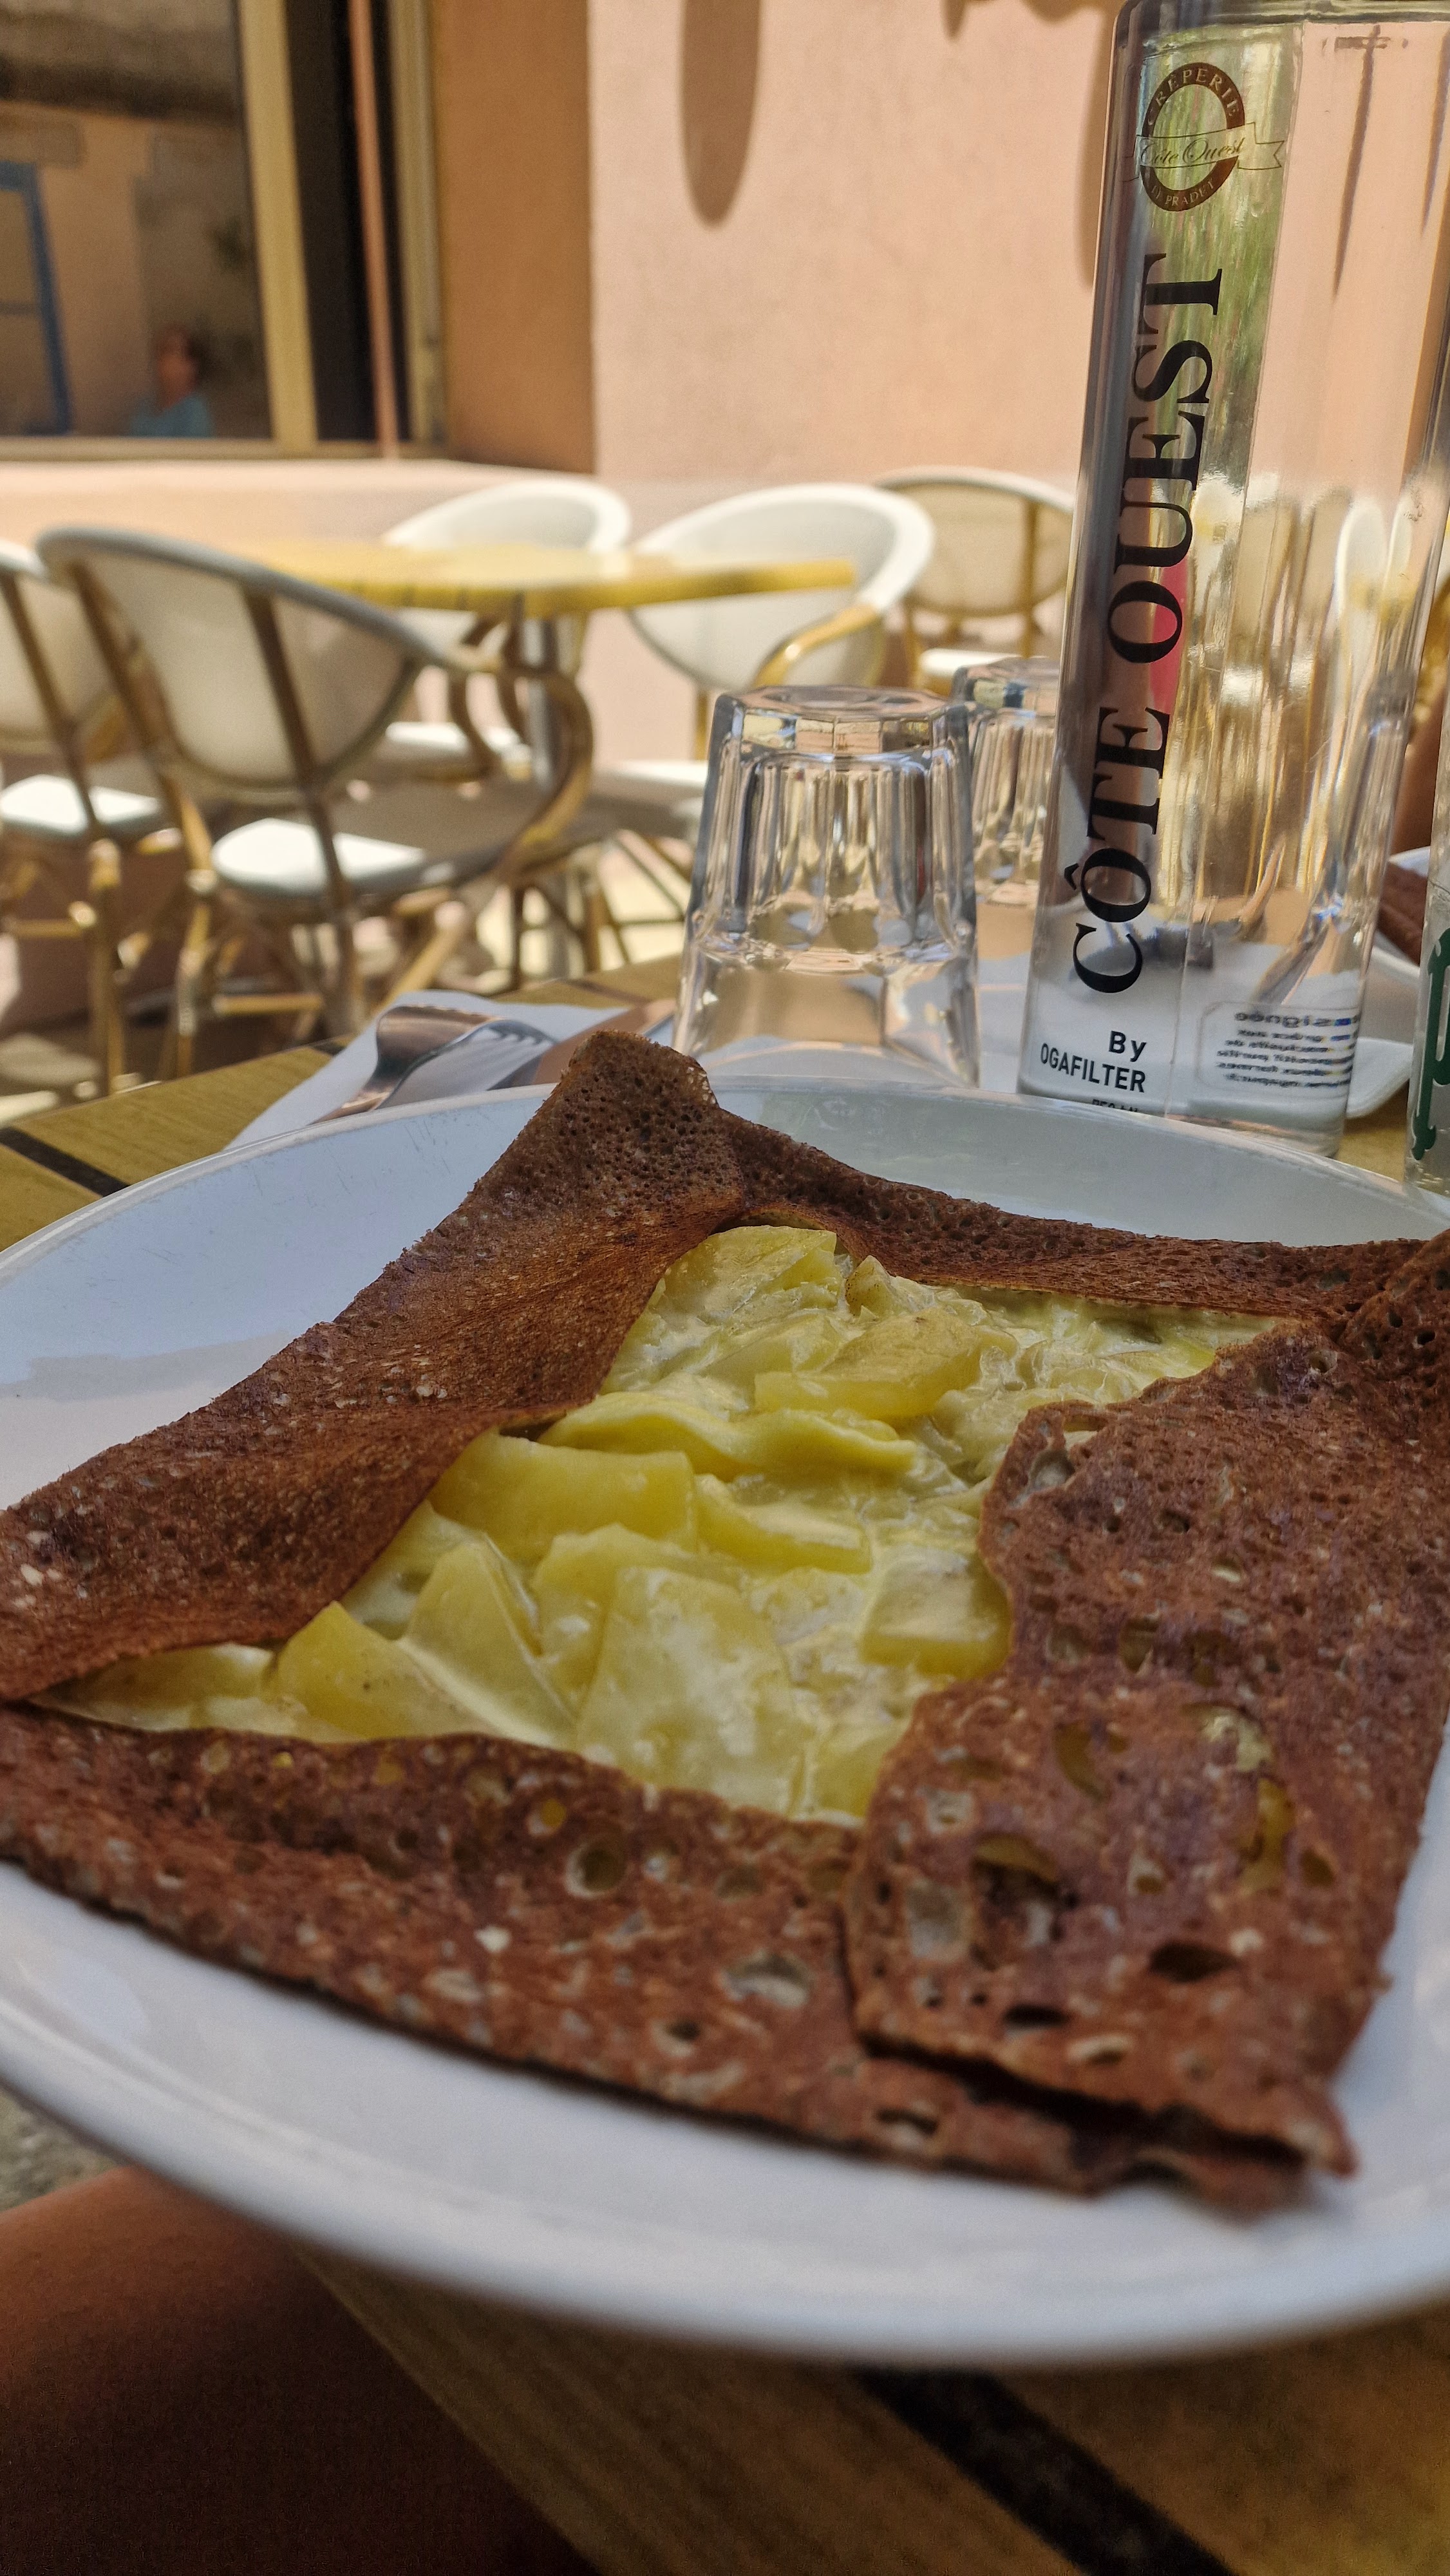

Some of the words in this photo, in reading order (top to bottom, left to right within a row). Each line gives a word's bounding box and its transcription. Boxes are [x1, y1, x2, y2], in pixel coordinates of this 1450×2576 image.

[1182, 137, 1245, 164] Ouest
[1107, 252, 1223, 664] OUEST
[1064, 706, 1171, 994] CÔTE
[1039, 1042, 1147, 1094] OGAFILTER
[1108, 1030, 1147, 1063] By
